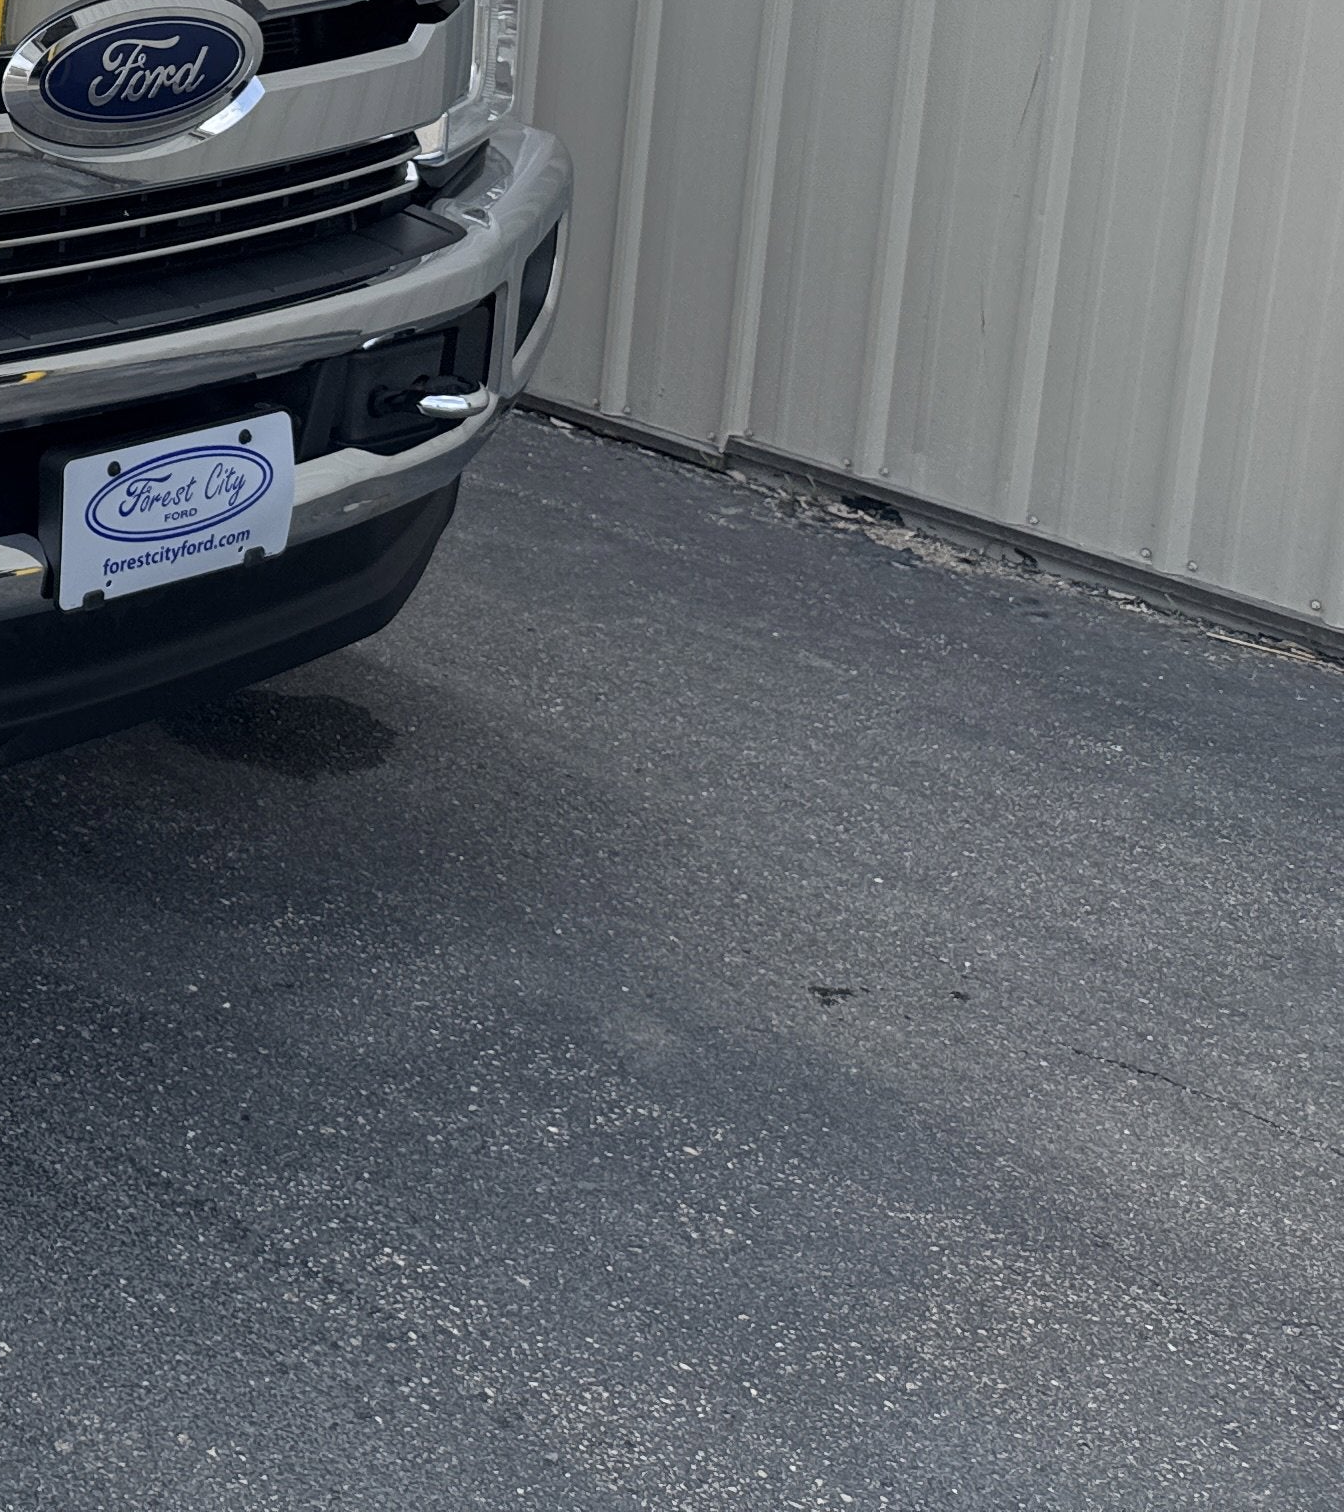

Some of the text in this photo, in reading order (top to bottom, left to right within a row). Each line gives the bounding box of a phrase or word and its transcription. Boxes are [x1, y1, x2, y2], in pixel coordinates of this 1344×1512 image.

[87, 34, 209, 108] Ford
[118, 462, 246, 518] Forest City
[163, 506, 198, 523] FORD
[102, 528, 251, 576] forestcityford.com
